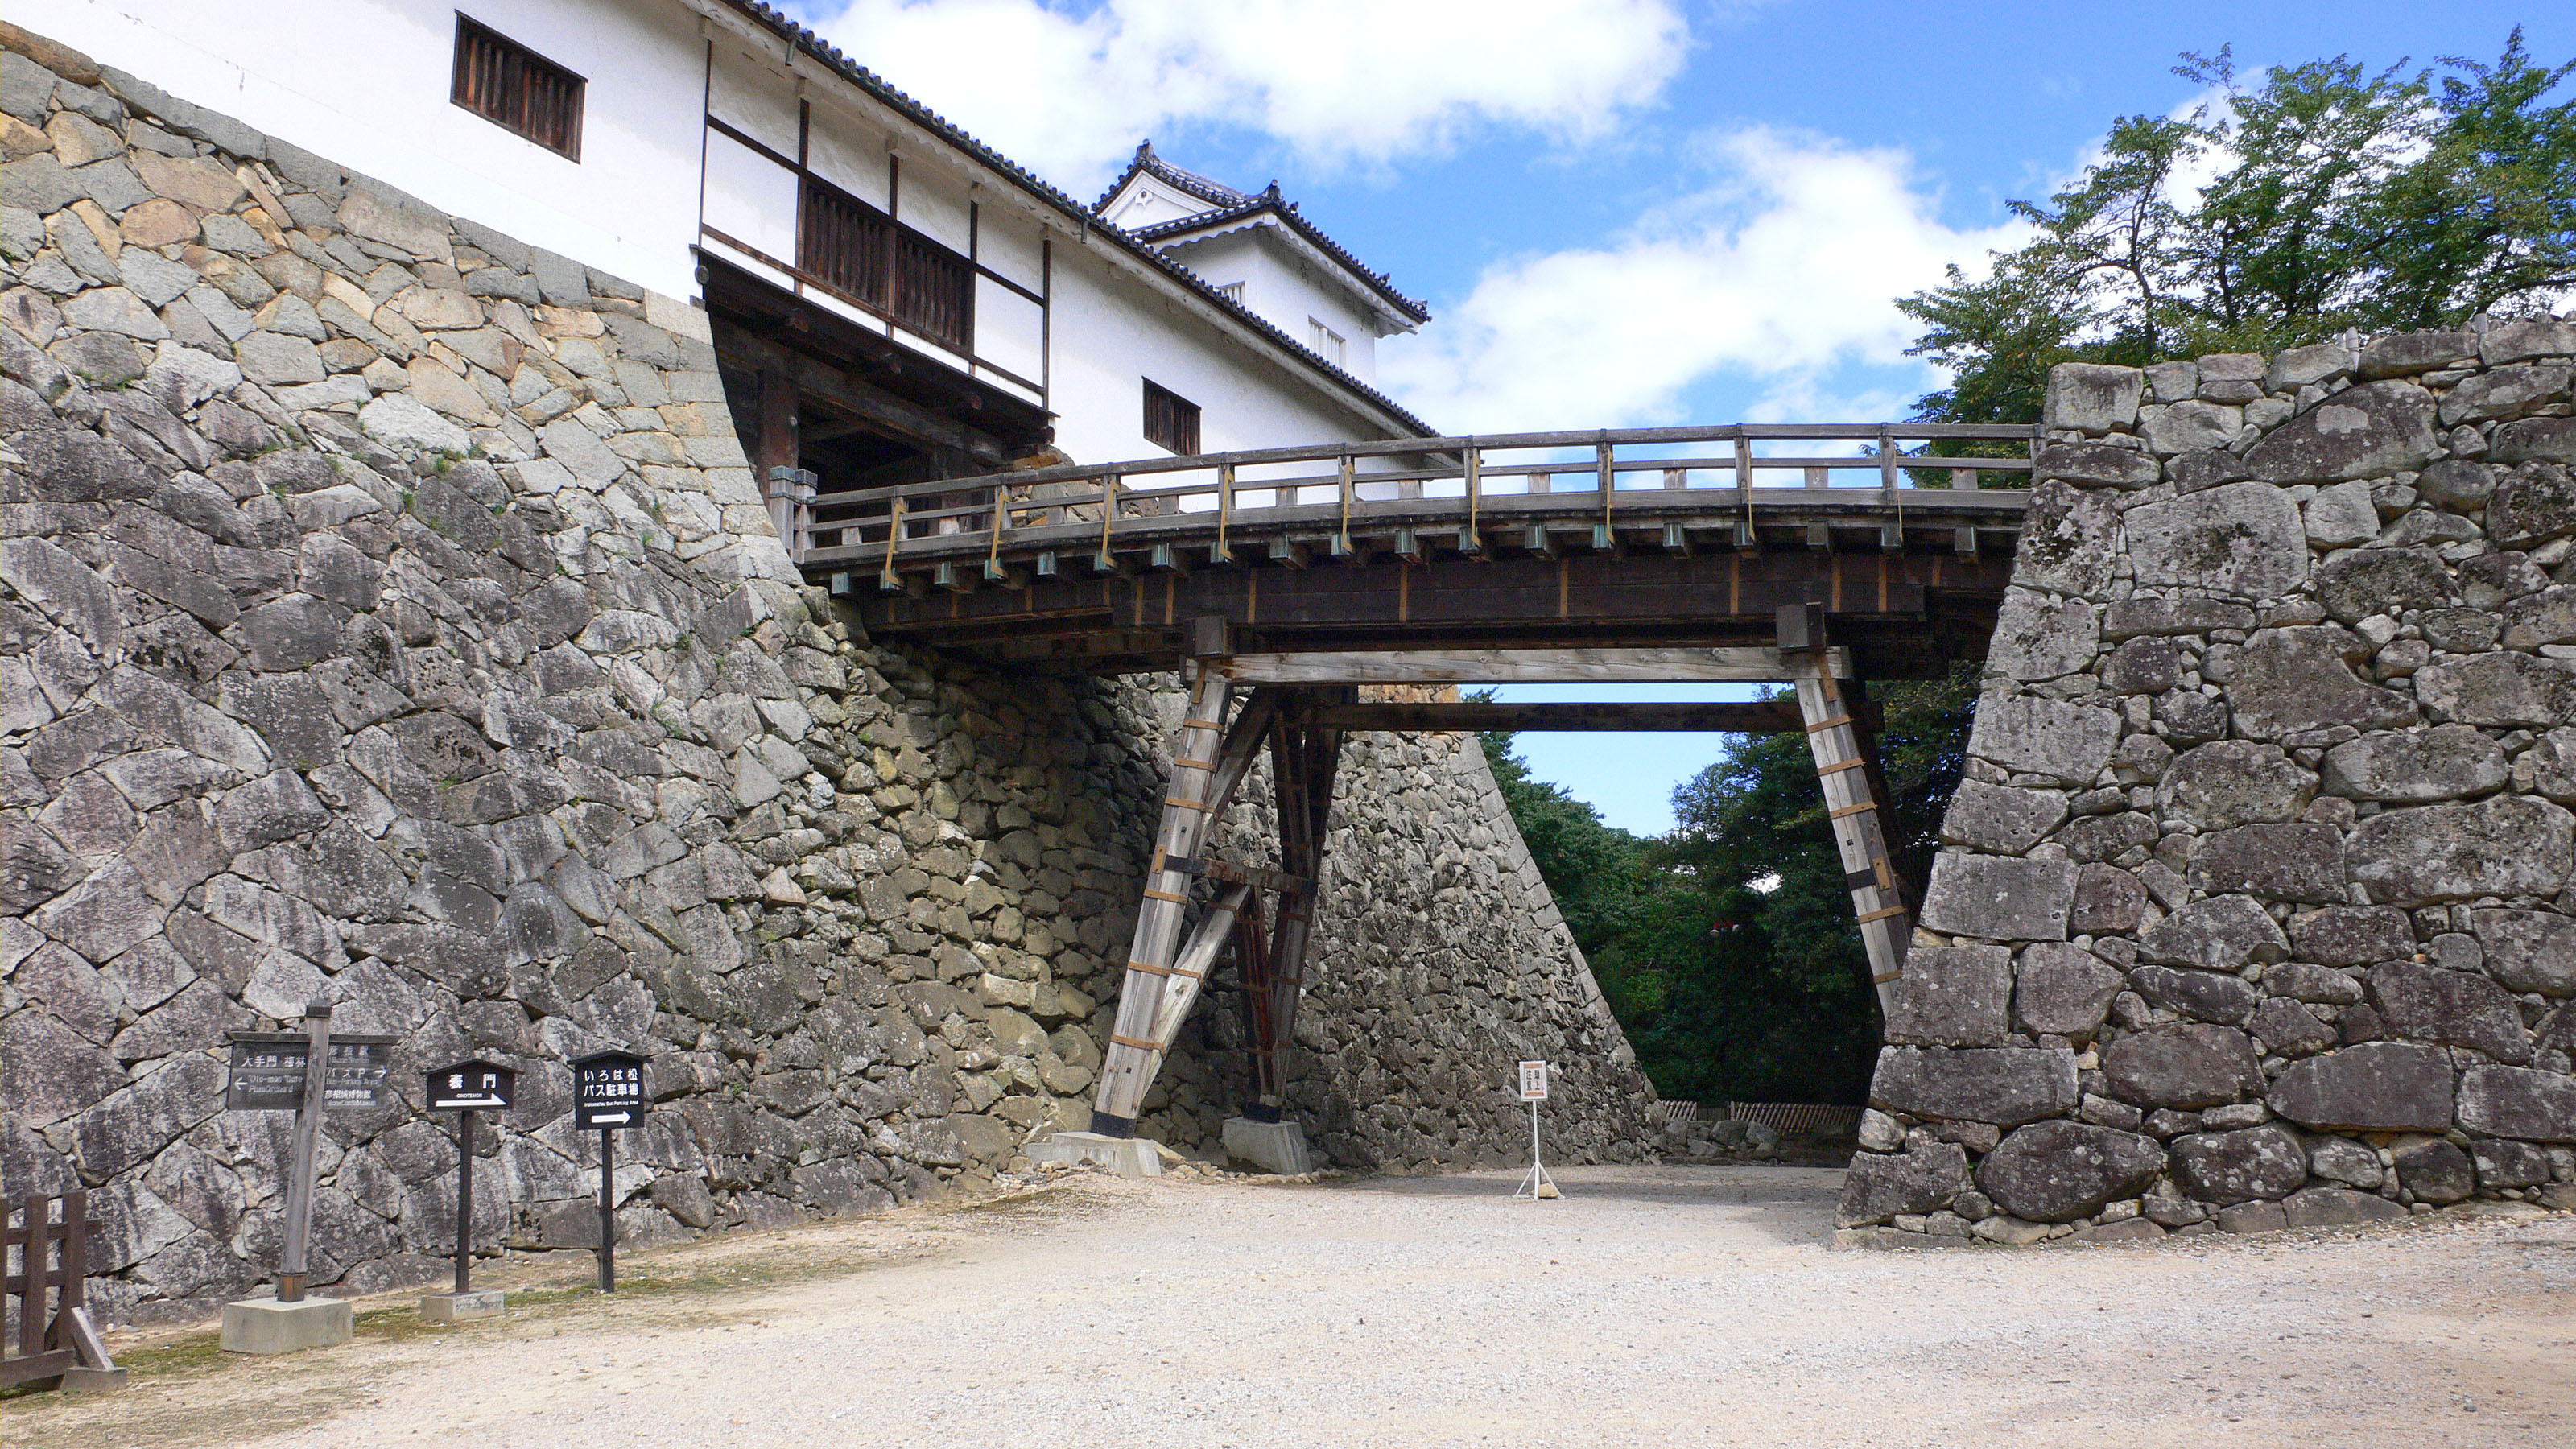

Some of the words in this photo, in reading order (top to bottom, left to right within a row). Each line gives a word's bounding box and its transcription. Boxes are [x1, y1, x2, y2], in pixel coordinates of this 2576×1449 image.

[584, 1068, 638, 1081] いろは松
[1526, 1070, 1532, 1091] 注意
[584, 1083, 638, 1096] バス駐車場
